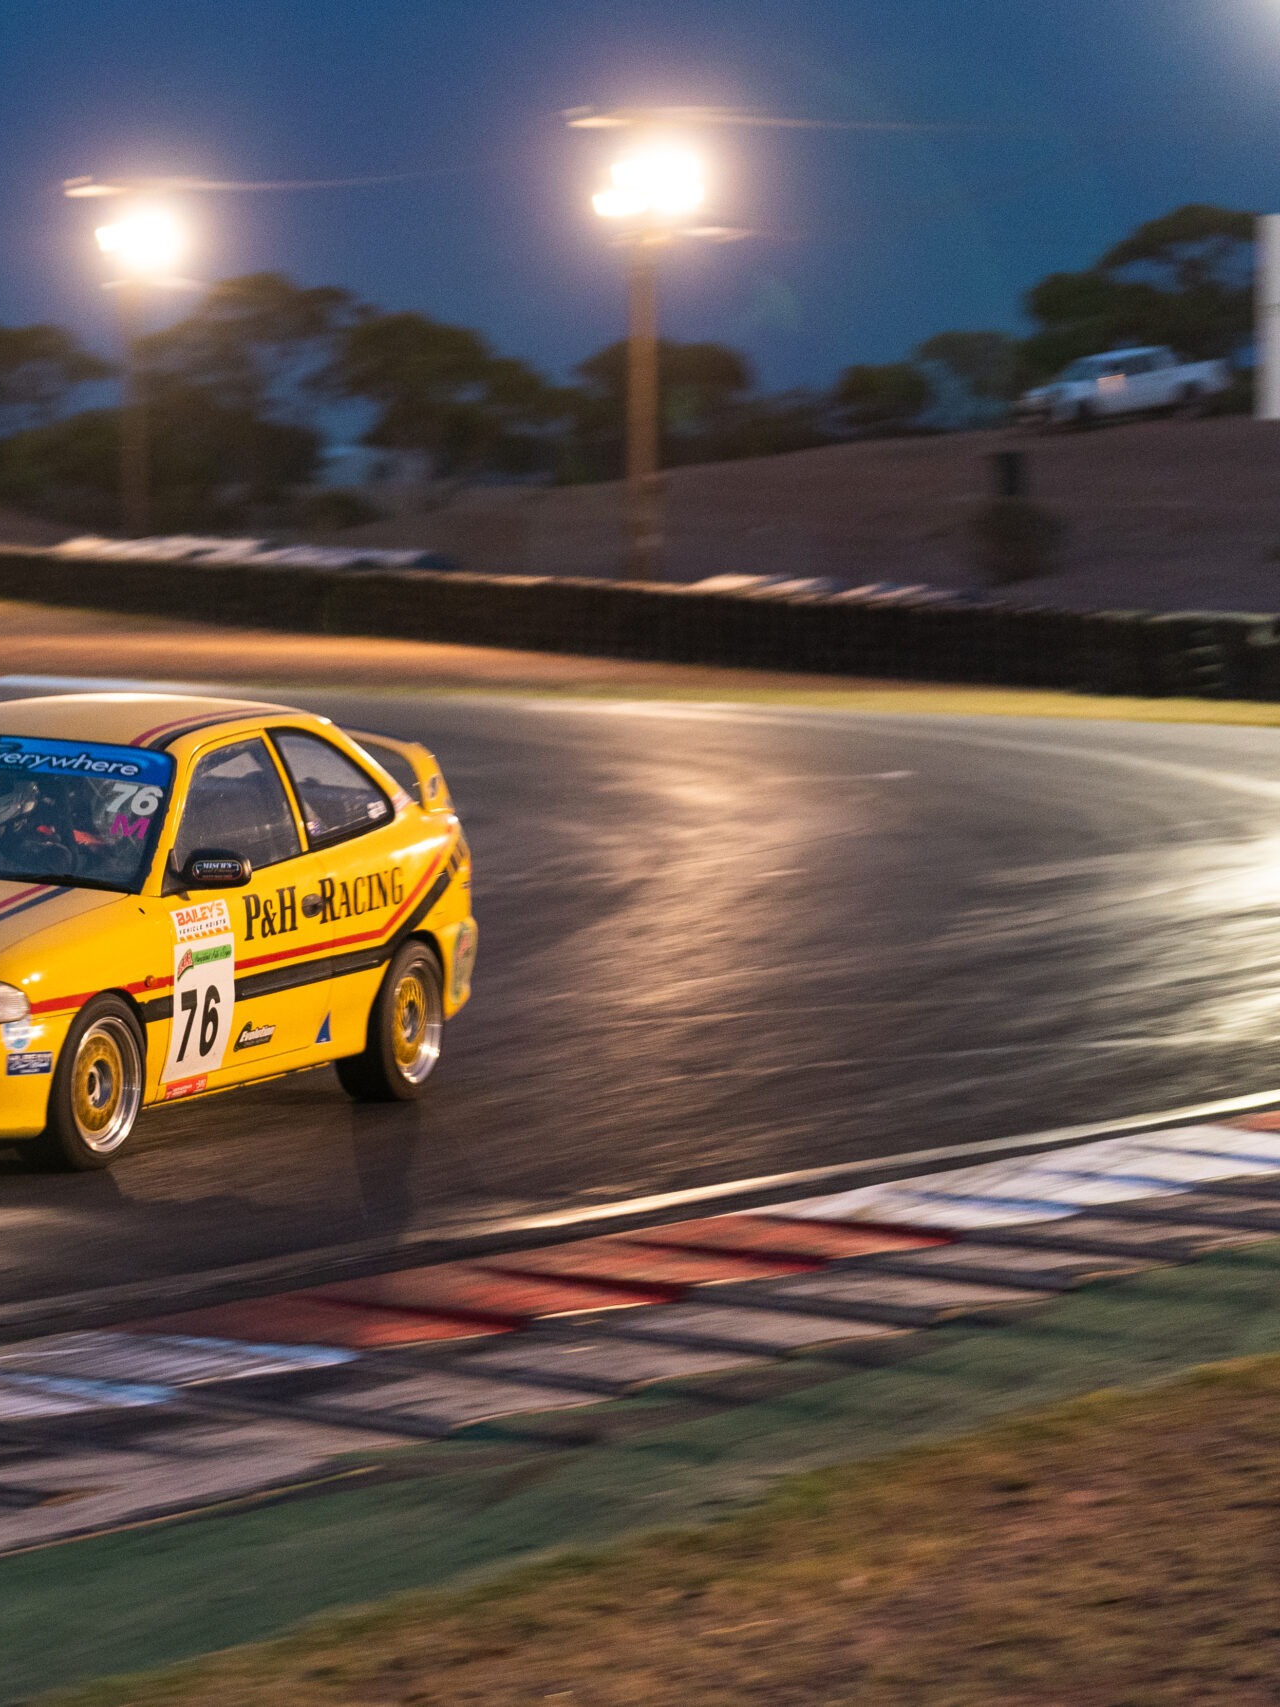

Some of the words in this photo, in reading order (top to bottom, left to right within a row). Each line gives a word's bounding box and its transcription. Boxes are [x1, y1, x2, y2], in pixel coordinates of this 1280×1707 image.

[105, 782, 163, 817] 76
[110, 814, 150, 840] M
[175, 901, 225, 927] BAILEY'S
[178, 924, 203, 935] VEHICLE
[205, 917, 227, 929] HOISTS
[242, 885, 298, 942] P&H
[175, 984, 221, 1063] 76
